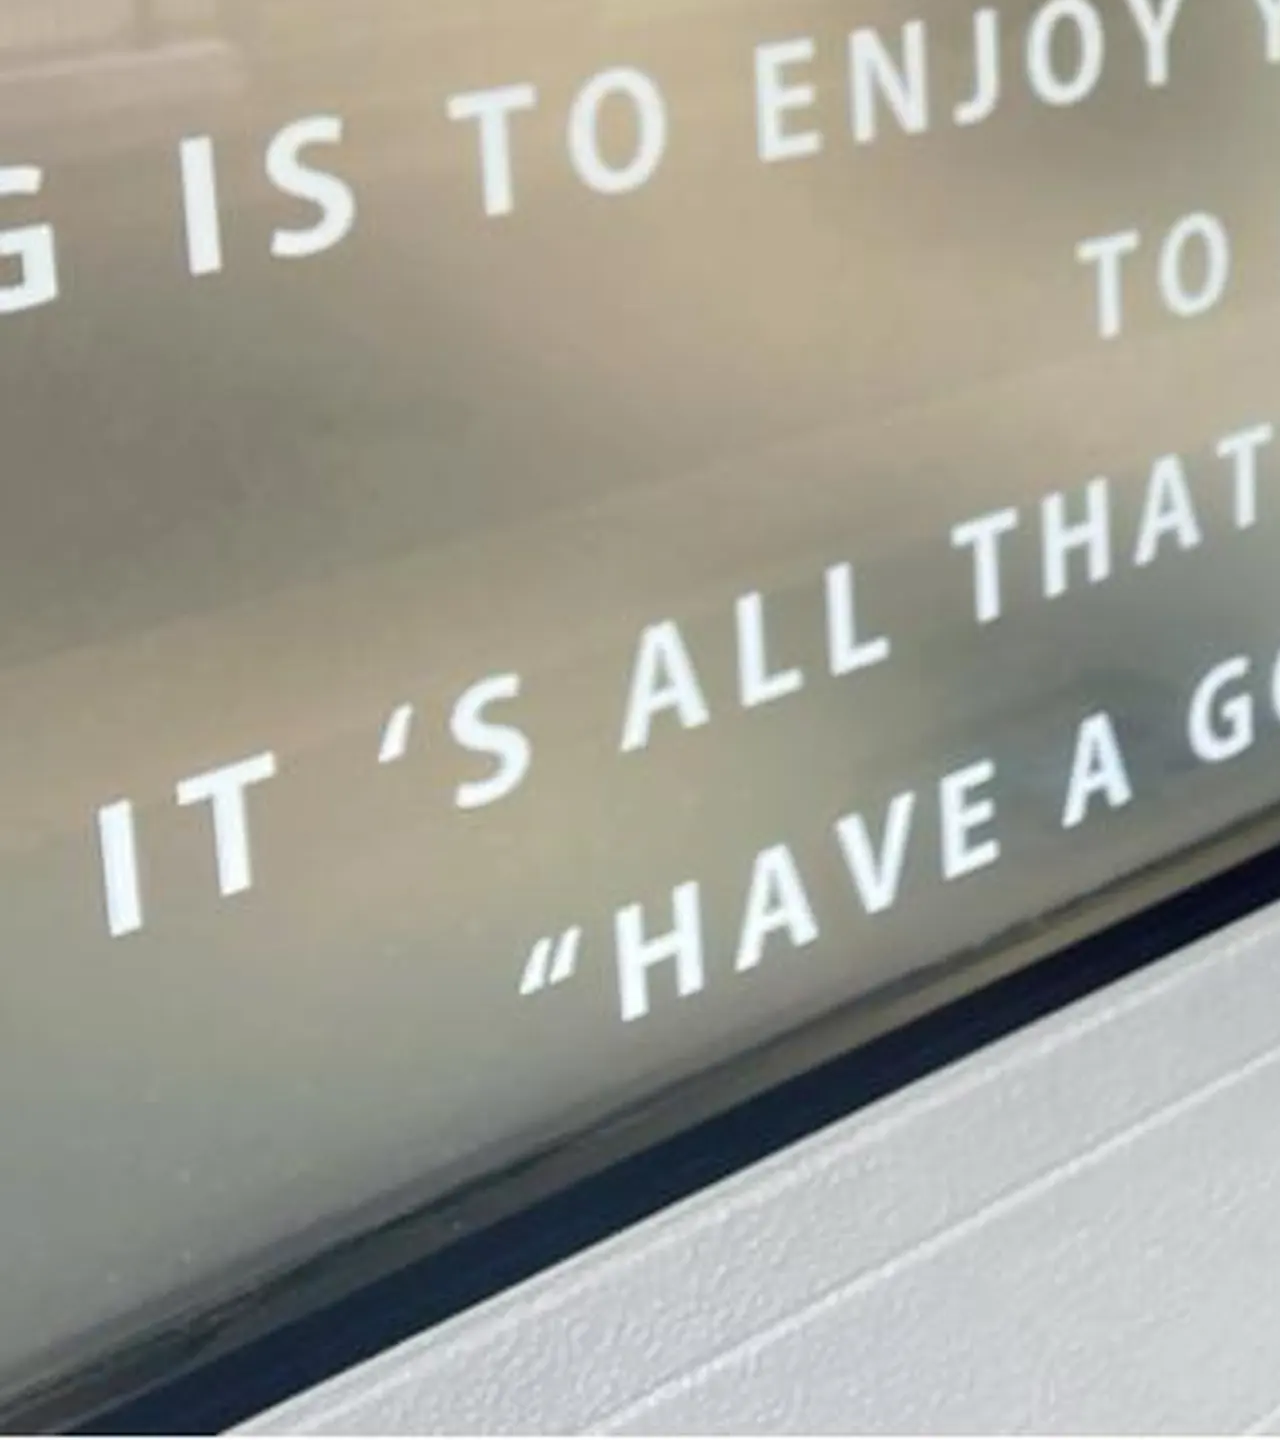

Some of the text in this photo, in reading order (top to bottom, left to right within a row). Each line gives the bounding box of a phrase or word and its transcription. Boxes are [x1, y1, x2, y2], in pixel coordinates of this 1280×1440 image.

[179, 114, 356, 277] IS
[446, 66, 668, 217] TO
[1075, 211, 1229, 340] TO
[97, 749, 278, 939] IT
[617, 560, 890, 754] ALL
[950, 422, 1273, 623] THAT
[1060, 710, 1134, 830] A
